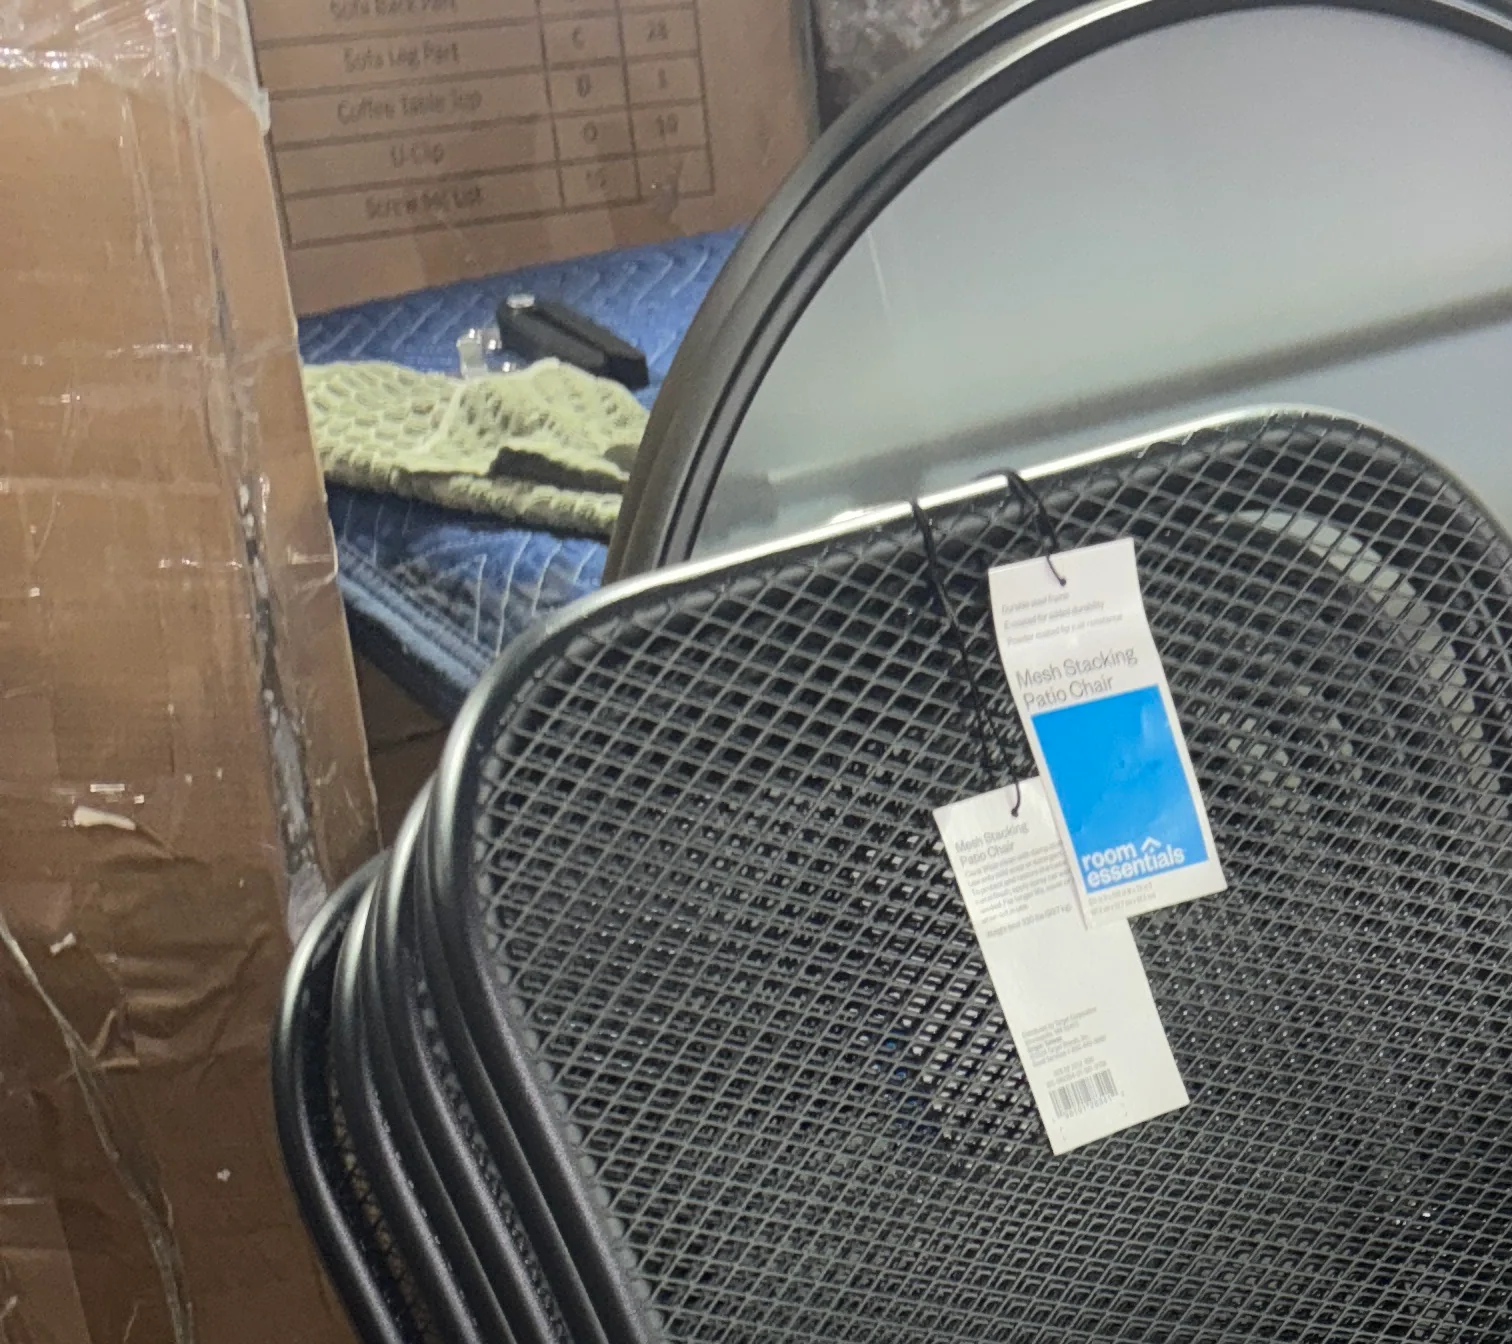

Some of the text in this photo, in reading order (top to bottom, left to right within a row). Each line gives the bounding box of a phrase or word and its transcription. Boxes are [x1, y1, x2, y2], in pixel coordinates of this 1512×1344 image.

[1016, 647, 1138, 690] Mesh Stacking
[1023, 674, 1114, 712] Patio Chair
[1082, 842, 1137, 872] room
[1087, 843, 1185, 888] essentials
